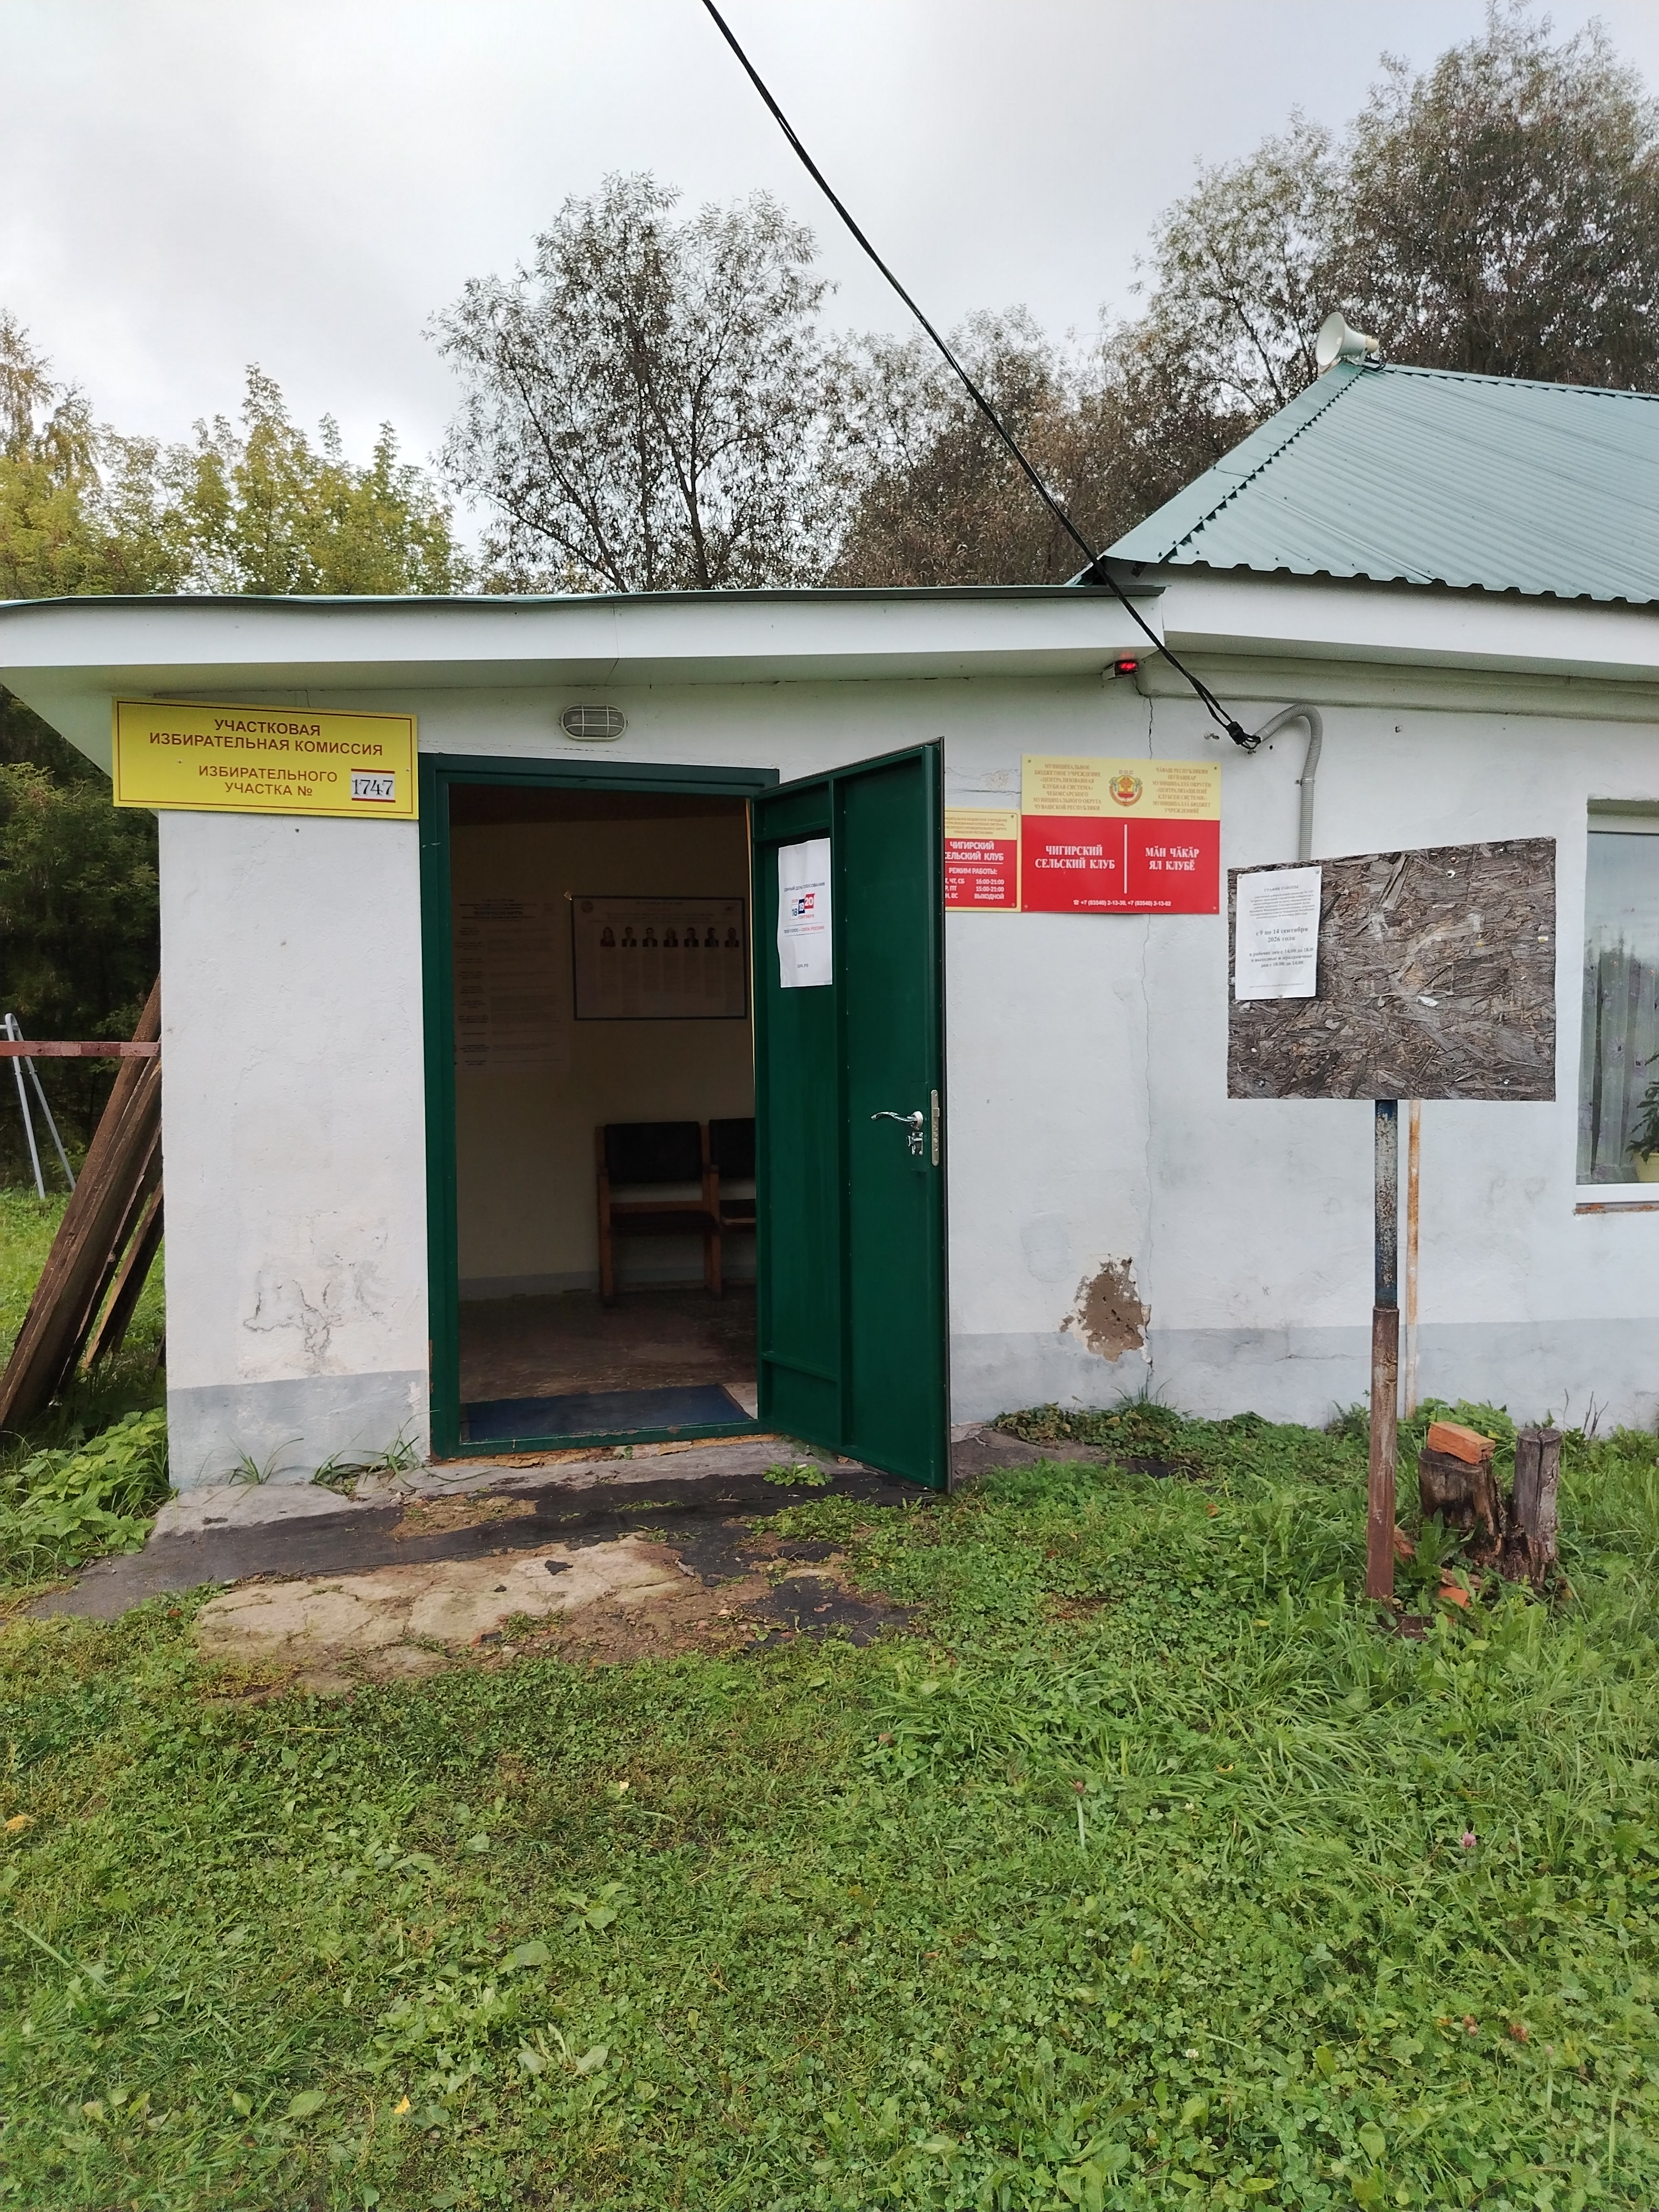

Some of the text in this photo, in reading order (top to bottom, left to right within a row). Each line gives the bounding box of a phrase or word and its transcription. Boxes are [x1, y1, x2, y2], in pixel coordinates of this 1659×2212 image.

[214, 719, 320, 736] УЧАСТКОВАЯ
[149, 732, 382, 755] ИЗБИРАТЕЛЬНАЯ КОМИССИЯ
[199, 765, 337, 782] ИЗБИРАТЕЛЬНОГО
[225, 779, 394, 796] УЧАСТКА № 1747
[950, 841, 994, 850] ЧИГИРСКИЙ
[1045, 844, 1103, 856] ЧИГИРСКИЙ
[984, 853, 1004, 861] КЛУБ
[1035, 857, 1115, 869] СЕЛЬСКИЙ КЛУБ
[1149, 860, 1162, 870] ЯЛ
[792, 896, 813, 916] 18 19 20
